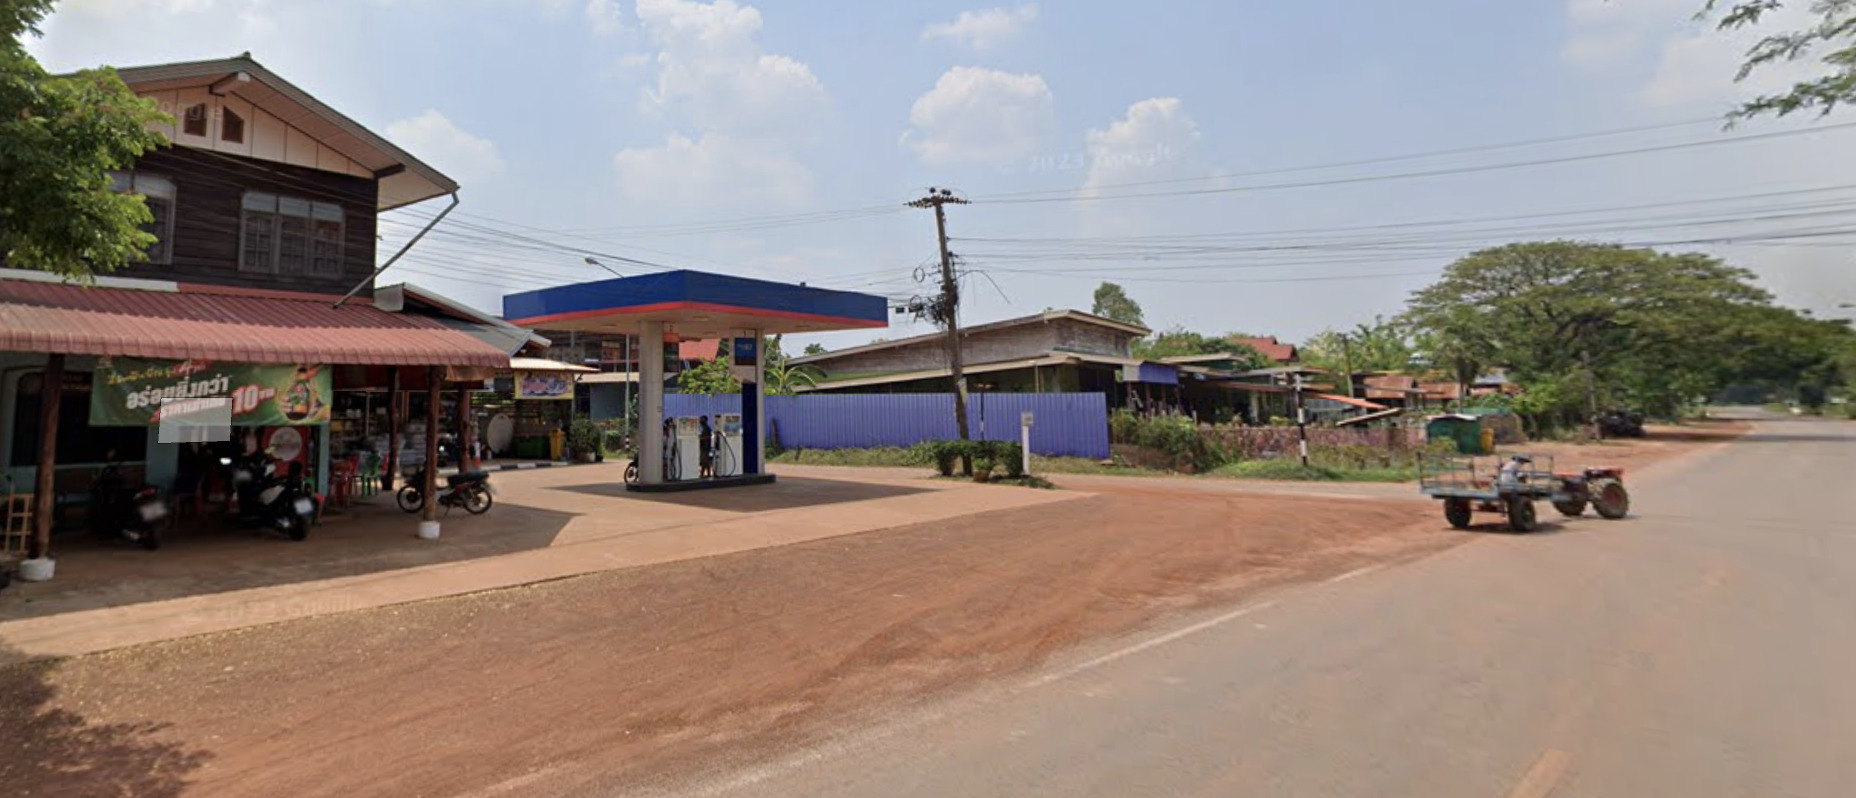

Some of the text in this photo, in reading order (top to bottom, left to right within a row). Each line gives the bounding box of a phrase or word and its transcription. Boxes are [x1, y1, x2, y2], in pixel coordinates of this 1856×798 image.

[126, 374, 229, 409] อร่อยยิ่งกว่า
[232, 385, 259, 413] 10
